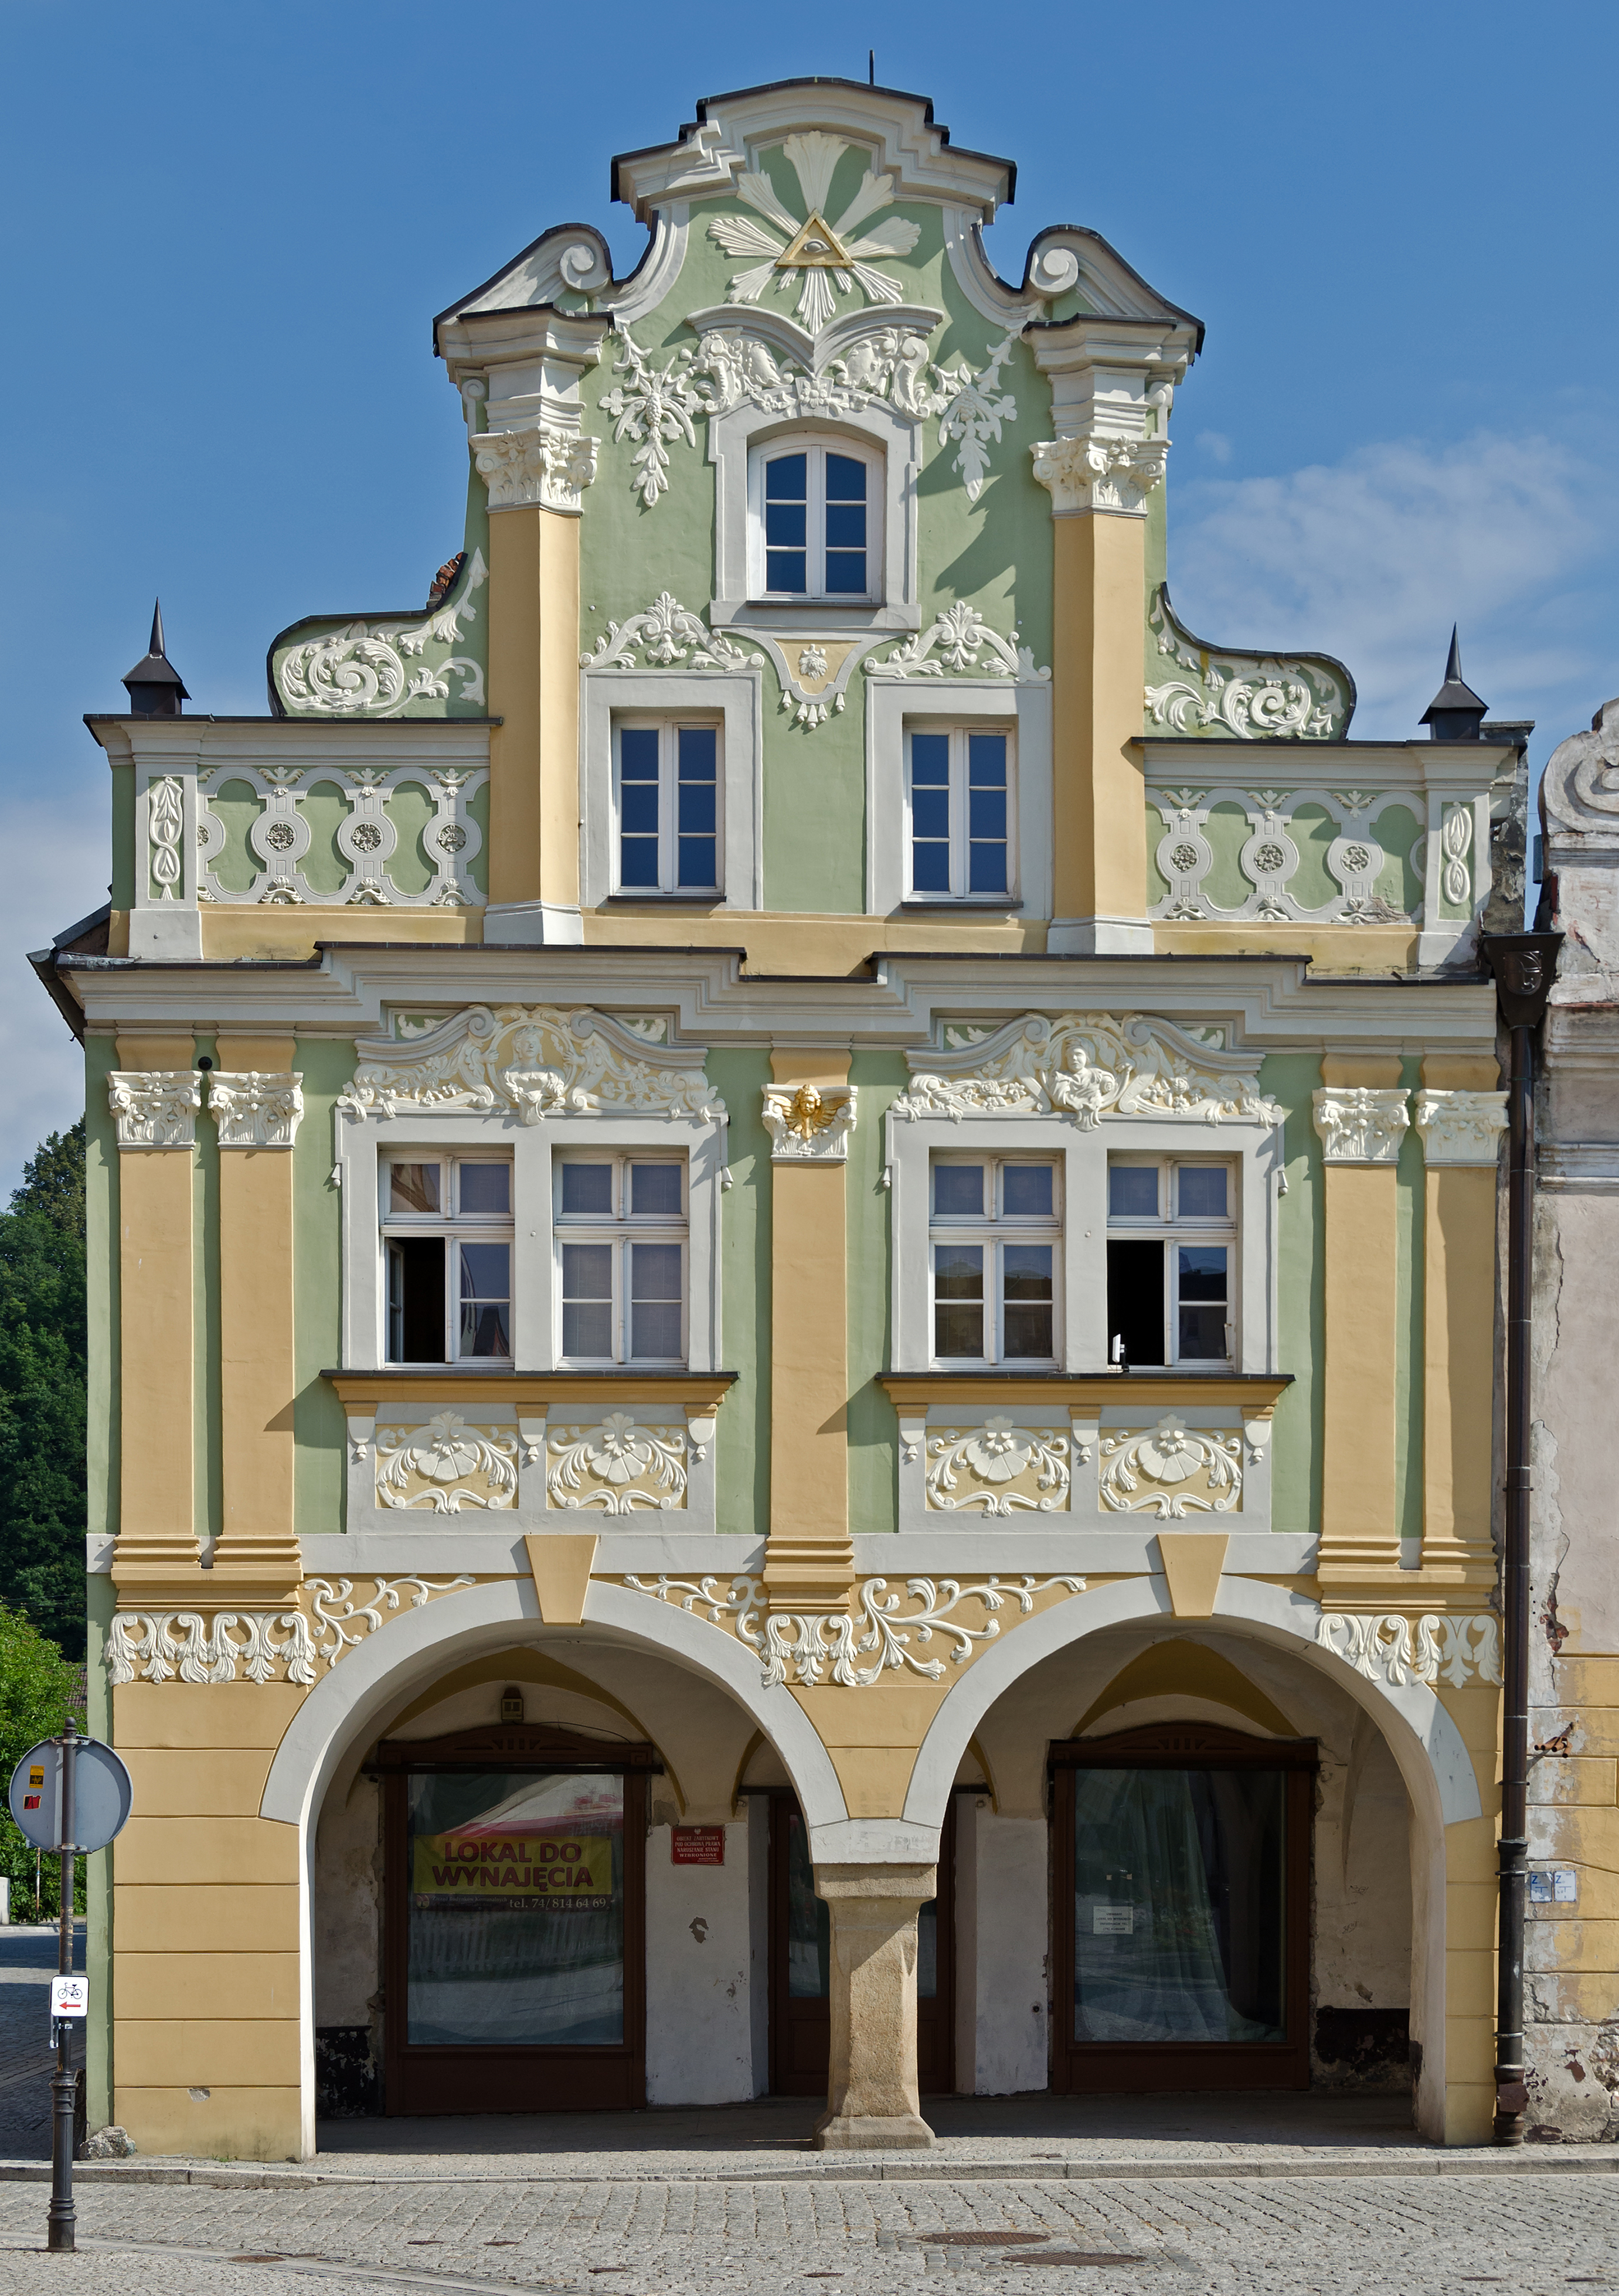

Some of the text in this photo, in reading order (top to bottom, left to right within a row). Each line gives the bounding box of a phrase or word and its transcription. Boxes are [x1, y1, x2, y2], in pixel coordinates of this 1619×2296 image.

[445, 1842, 581, 1863] LOKAL DO
[432, 1866, 593, 1892] WYNAJĘCIA
[1532, 1875, 1538, 1884] Z
[1556, 1875, 1562, 1883] Z
[509, 1898, 528, 1908] tel.
[552, 1898, 572, 1908] 814
[576, 1898, 589, 1908] 64
[593, 1898, 607, 1908] 69
